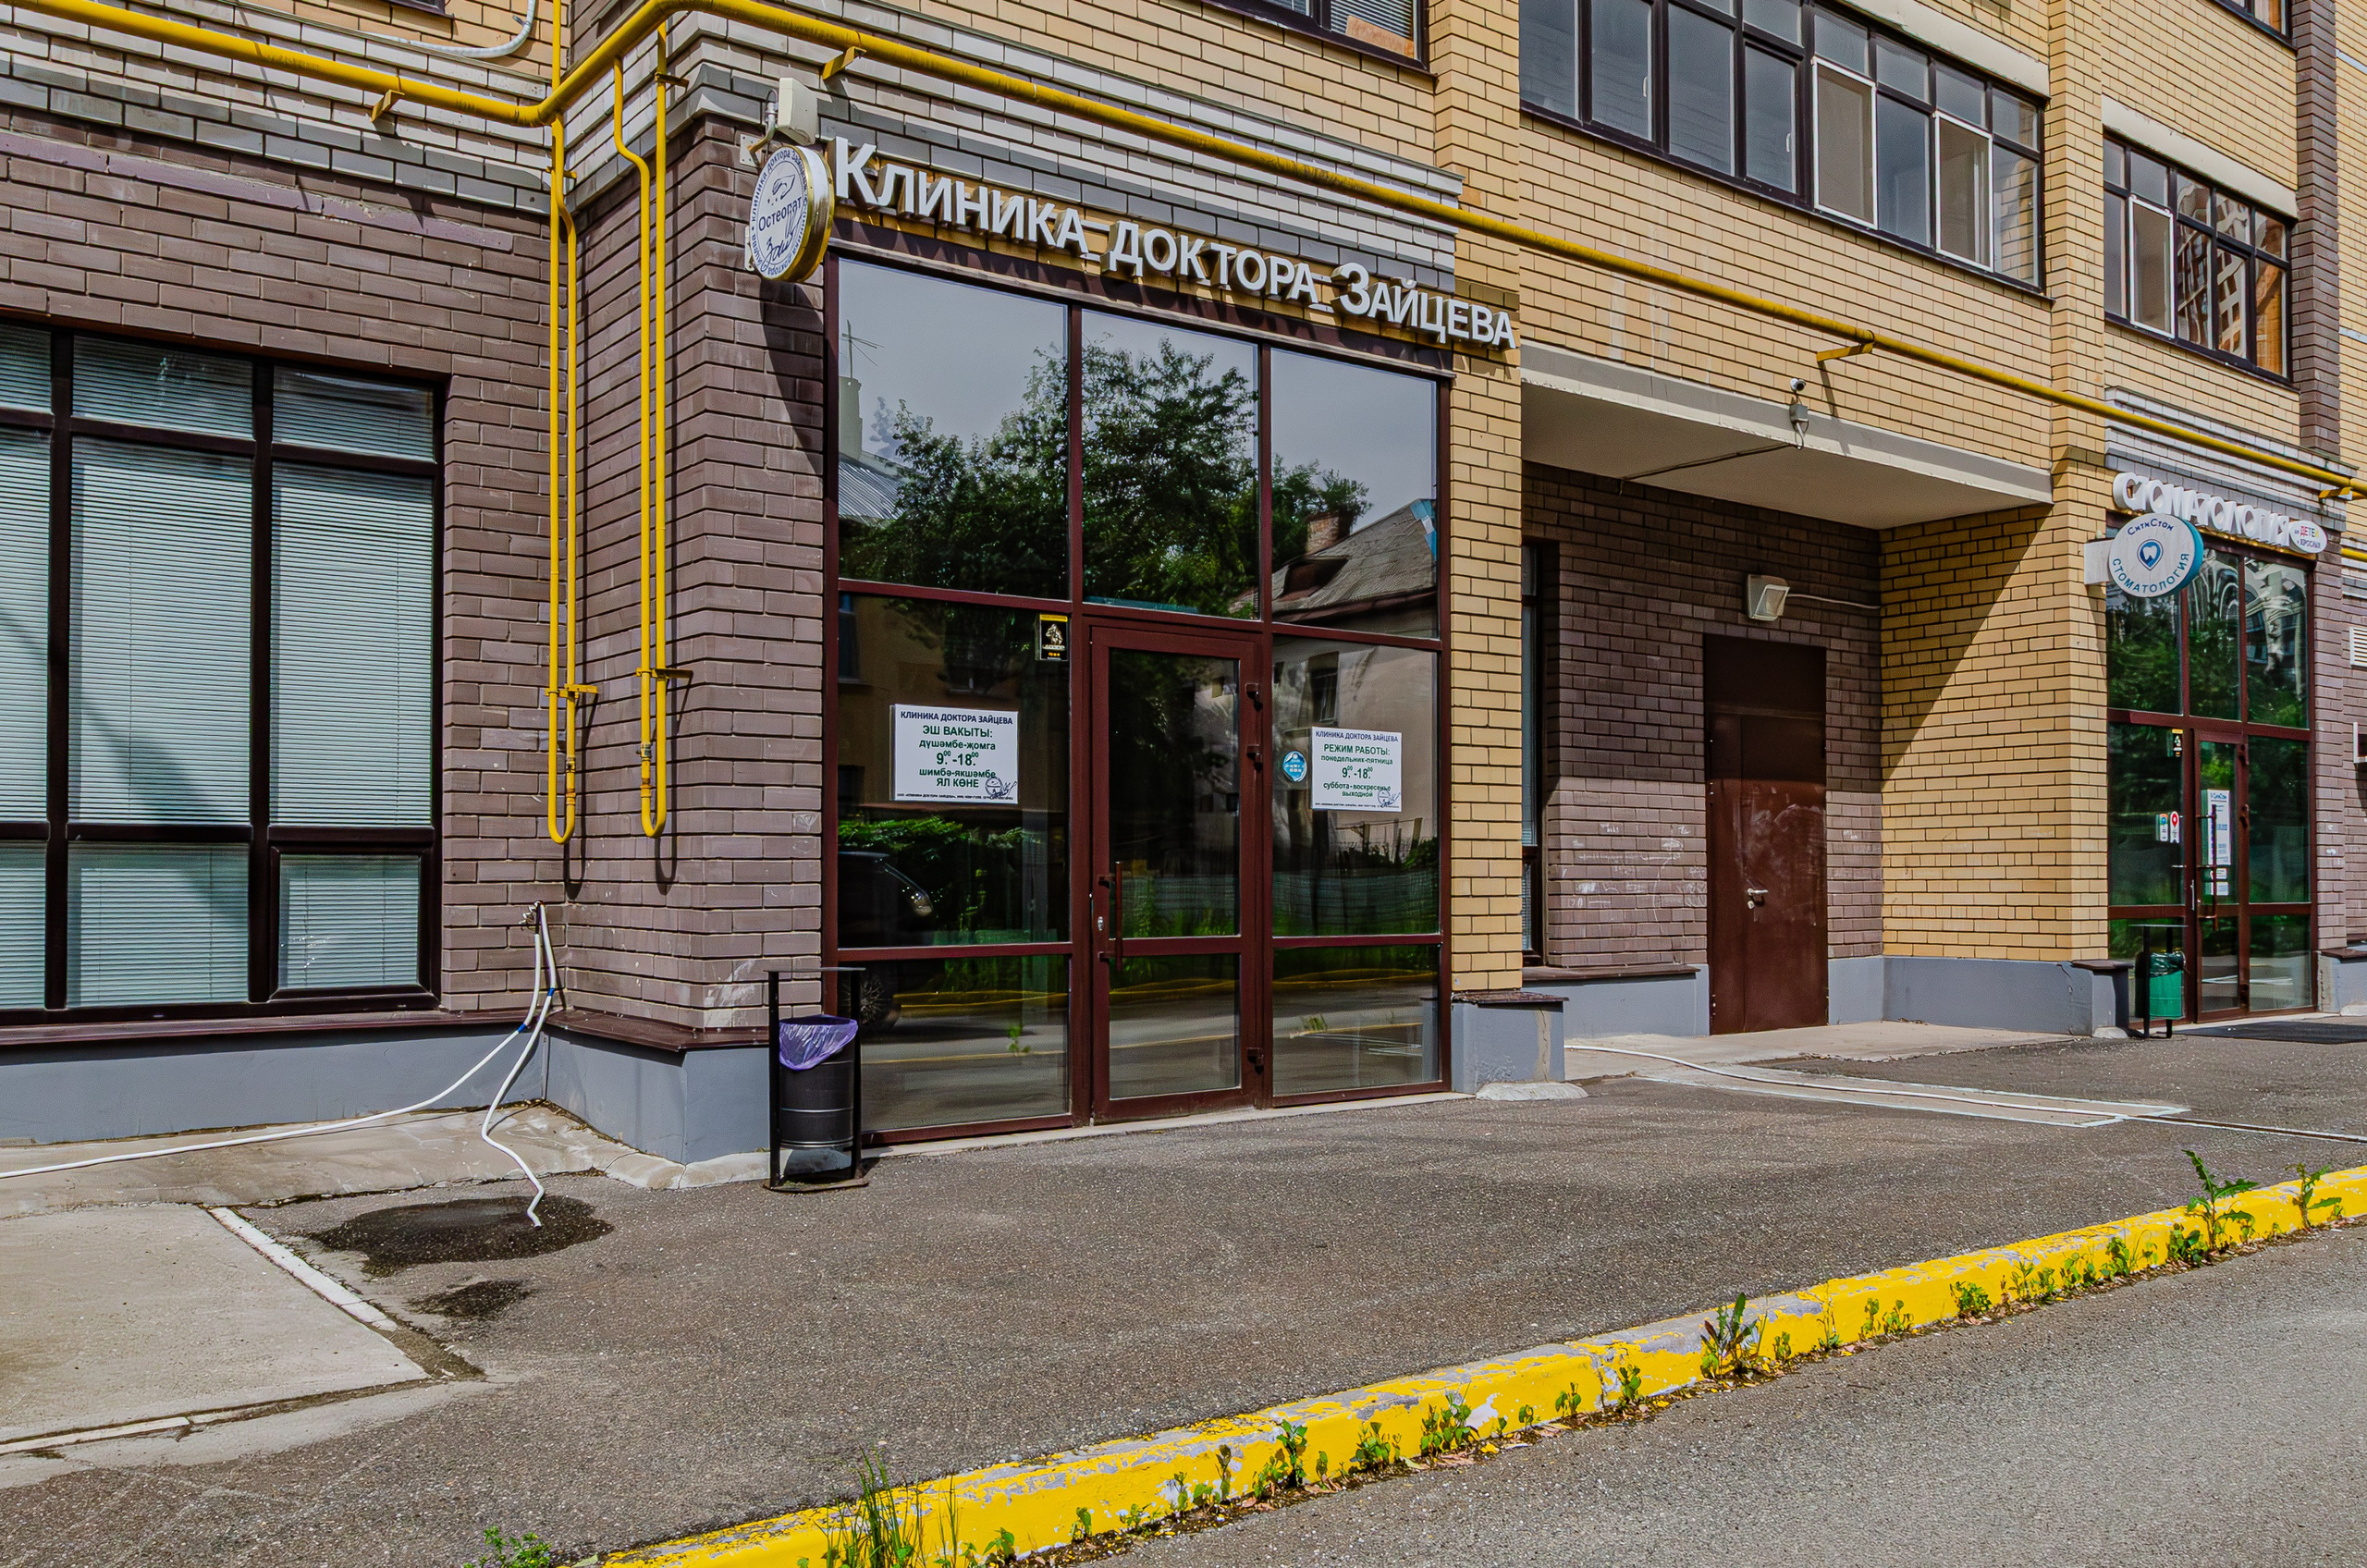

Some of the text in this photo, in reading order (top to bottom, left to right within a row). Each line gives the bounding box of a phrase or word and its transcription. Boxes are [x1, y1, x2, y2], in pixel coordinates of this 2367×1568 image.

[758, 196, 803, 232] Остеопат
[835, 136, 1088, 254] КЛИНИКА
[1110, 220, 1318, 304] ДОКТОРА
[1332, 263, 1516, 349] ЗАЙЦЕВА
[2112, 553, 2190, 594] СТОМАТОЛОГИЯ
[901, 711, 1013, 725] КЛИНИКА ДОКТОРА ЗАЙЦЕВА
[923, 725, 993, 738] ЭШ ВАКЫТЫ:
[1315, 730, 1399, 742] КЛИНИКА ДОКТОРА ЗАЙЦЕВА
[1323, 743, 1391, 755] РЕЖИМ РАБОТЫ:
[936, 778, 979, 788] ЯЛ КӨНЕ
